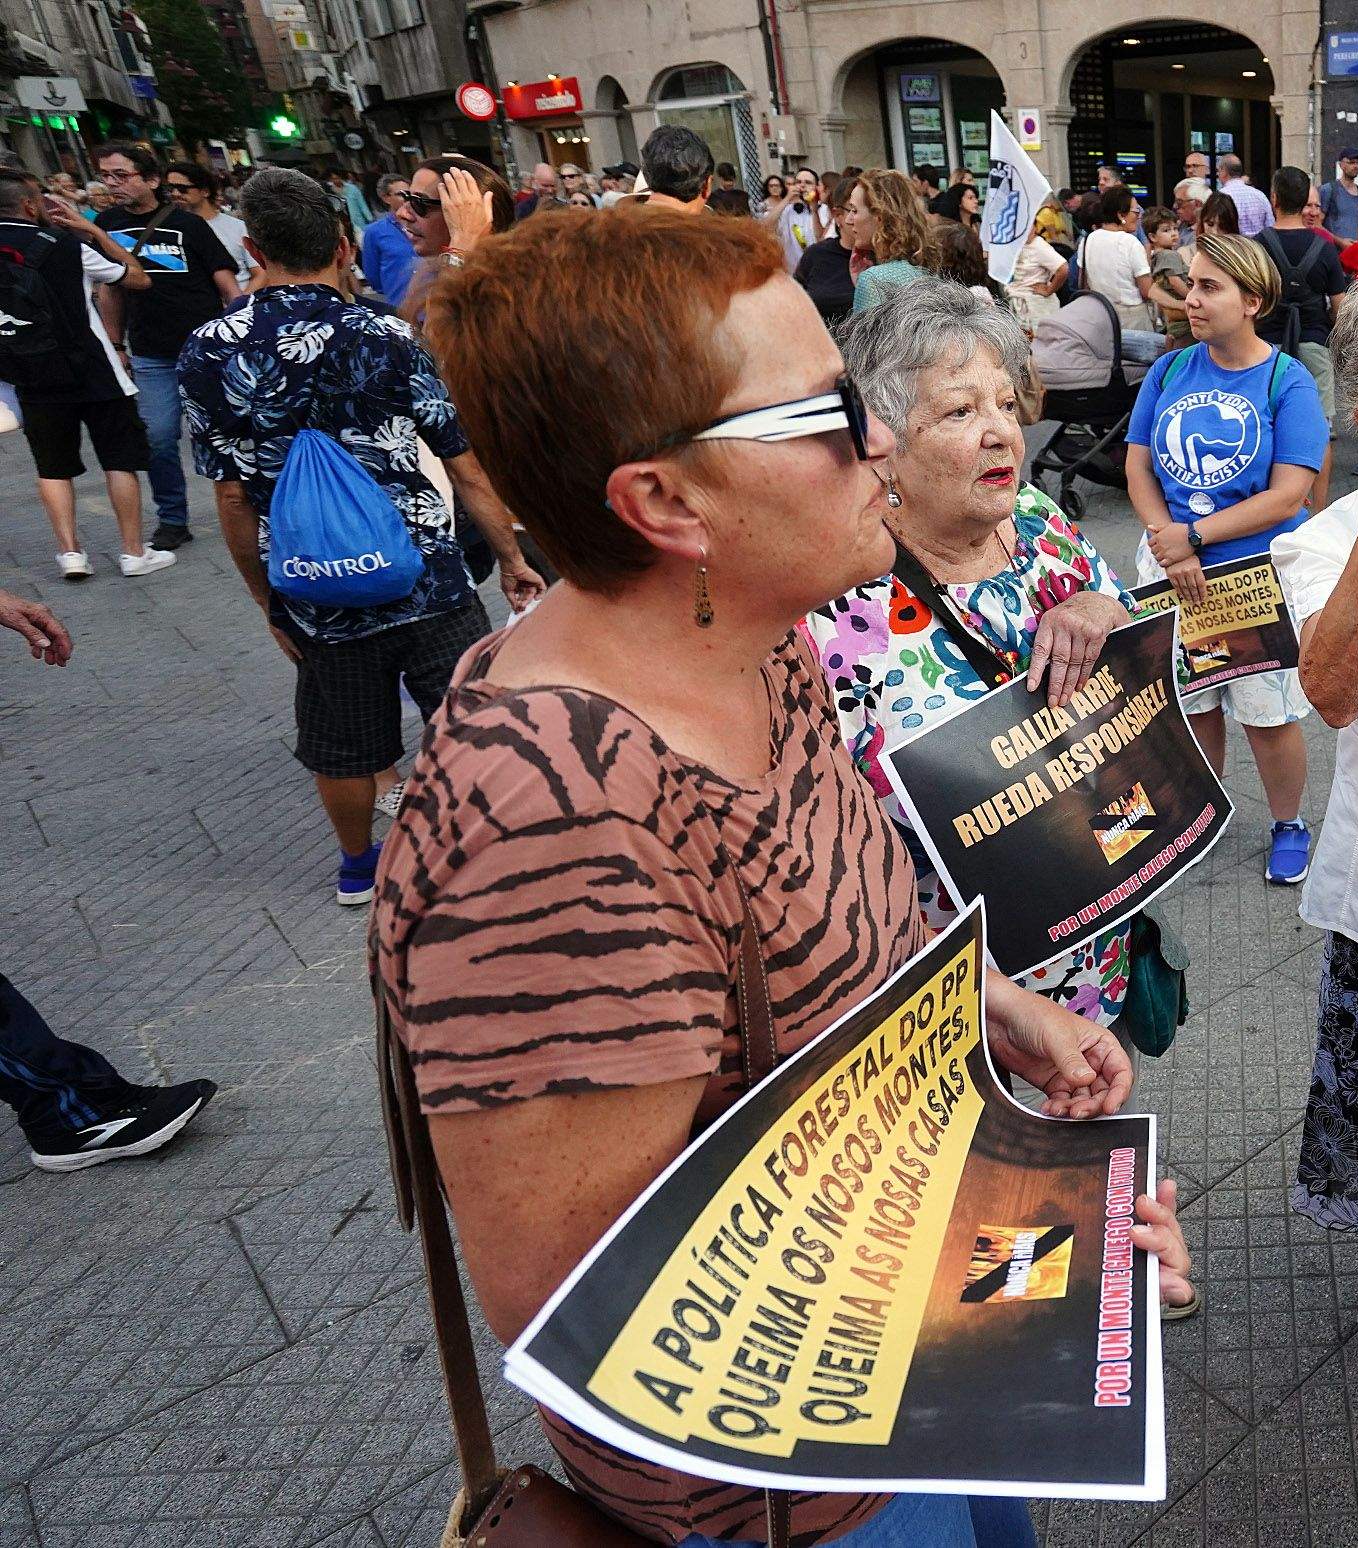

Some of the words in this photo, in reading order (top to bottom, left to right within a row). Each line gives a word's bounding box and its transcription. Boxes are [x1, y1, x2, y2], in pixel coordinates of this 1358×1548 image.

[1168, 394, 1213, 417] PONTE
[1217, 394, 1252, 419] VEDRA
[1160, 454, 1251, 487] ANTIFASCISTA
[282, 551, 392, 580] CONTROL
[1235, 573, 1252, 589] DO
[1254, 568, 1269, 583] PP
[1180, 622, 1195, 638] AS
[1197, 611, 1235, 631] NOSAS
[1236, 602, 1273, 620] CASAS
[1184, 600, 1223, 618] NOSOS
[1225, 586, 1276, 608] MONTES,
[990, 704, 1077, 769] GALIZA
[1069, 664, 1125, 721] ARDE,
[952, 771, 1053, 848] RUEDA
[1045, 678, 1169, 793] RESPONSÁBEL!
[1101, 820, 1131, 845] NUNCA
[1047, 916, 1080, 942] POR
[1077, 902, 1100, 925] UN
[1097, 874, 1142, 913] MONTE
[1138, 845, 1178, 884] GALEGO
[1174, 830, 1199, 853] CON
[1194, 802, 1217, 837] FUTURO
[941, 958, 968, 1012] PP
[900, 992, 934, 1049] DO
[873, 1005, 970, 1134] MONTES,
[764, 1034, 893, 1200] FORESTAL
[908, 1057, 965, 1157] CASAS
[804, 1114, 882, 1239] NOSOS
[1108, 1147, 1136, 1189] FUTURO
[864, 1145, 931, 1250] NOSAS
[1106, 1186, 1135, 1218] CON
[781, 1227, 835, 1284] OS
[850, 1244, 904, 1293] AS
[1102, 1216, 1134, 1270] GALEGO
[652, 1184, 783, 1372] POLÍTICA
[1003, 1258, 1034, 1296] NUNCA
[1100, 1269, 1133, 1330] MONTE
[707, 1285, 816, 1439] QUEIMA
[800, 1295, 892, 1426] QUEIMA
[1097, 1329, 1133, 1362] UN
[634, 1370, 693, 1415] A
[1094, 1361, 1132, 1408] POR
